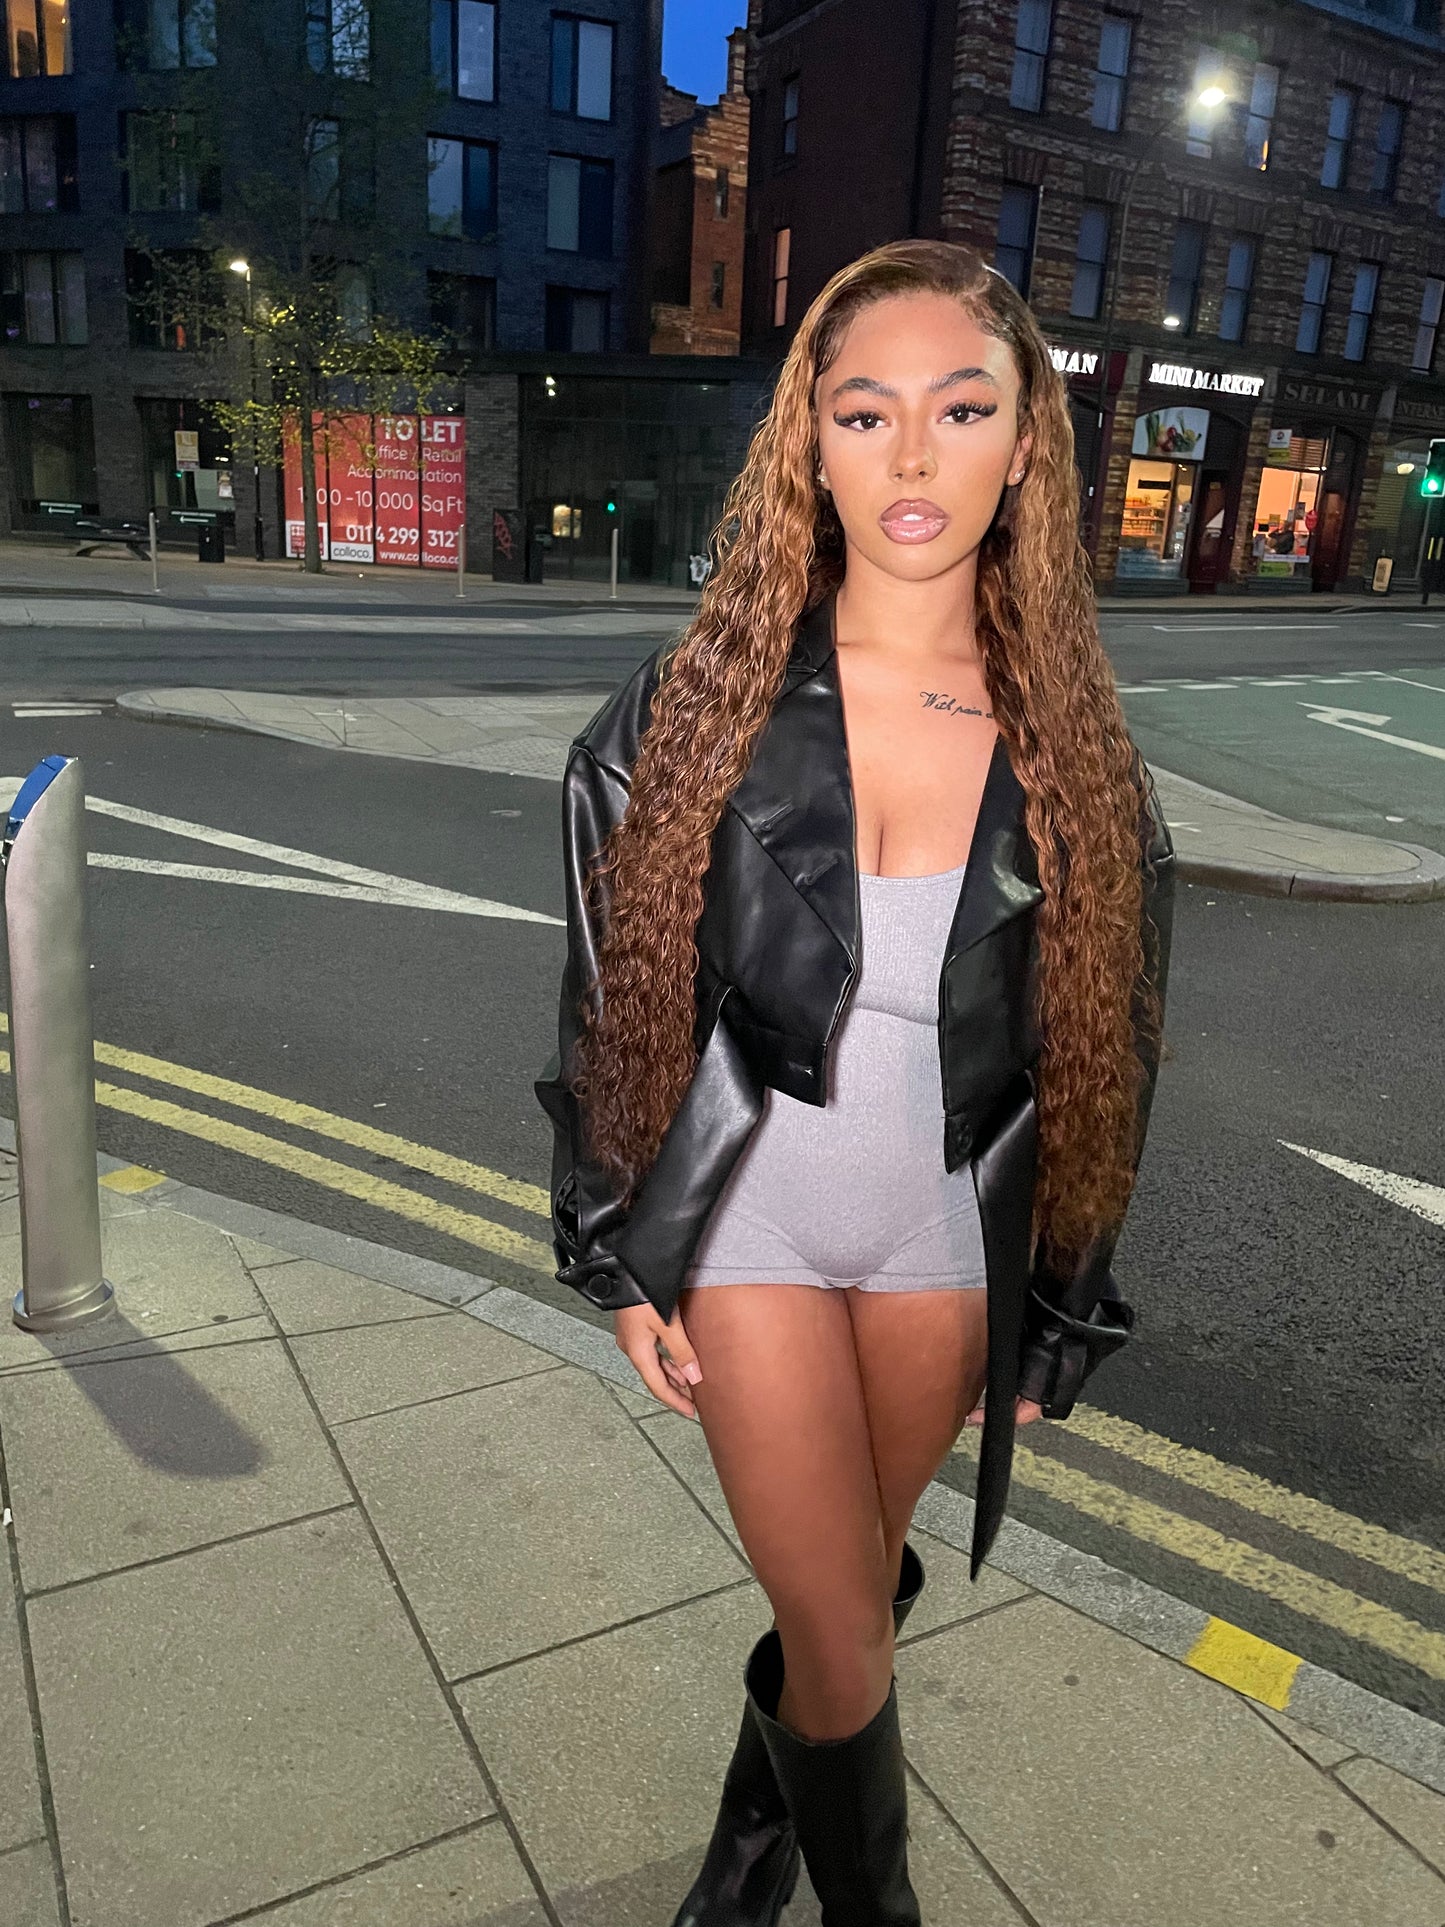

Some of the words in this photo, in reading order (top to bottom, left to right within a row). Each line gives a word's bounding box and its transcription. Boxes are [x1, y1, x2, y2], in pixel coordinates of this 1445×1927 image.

[1149, 363, 1194, 388] MINI
[1192, 370, 1264, 397] MARKET
[380, 418, 413, 441] TO
[421, 420, 461, 443] LET
[422, 494, 444, 517] Sq
[447, 496, 464, 514] Ft
[346, 523, 385, 544] 0114
[388, 526, 419, 546] 299
[920, 692, 956, 711] With
